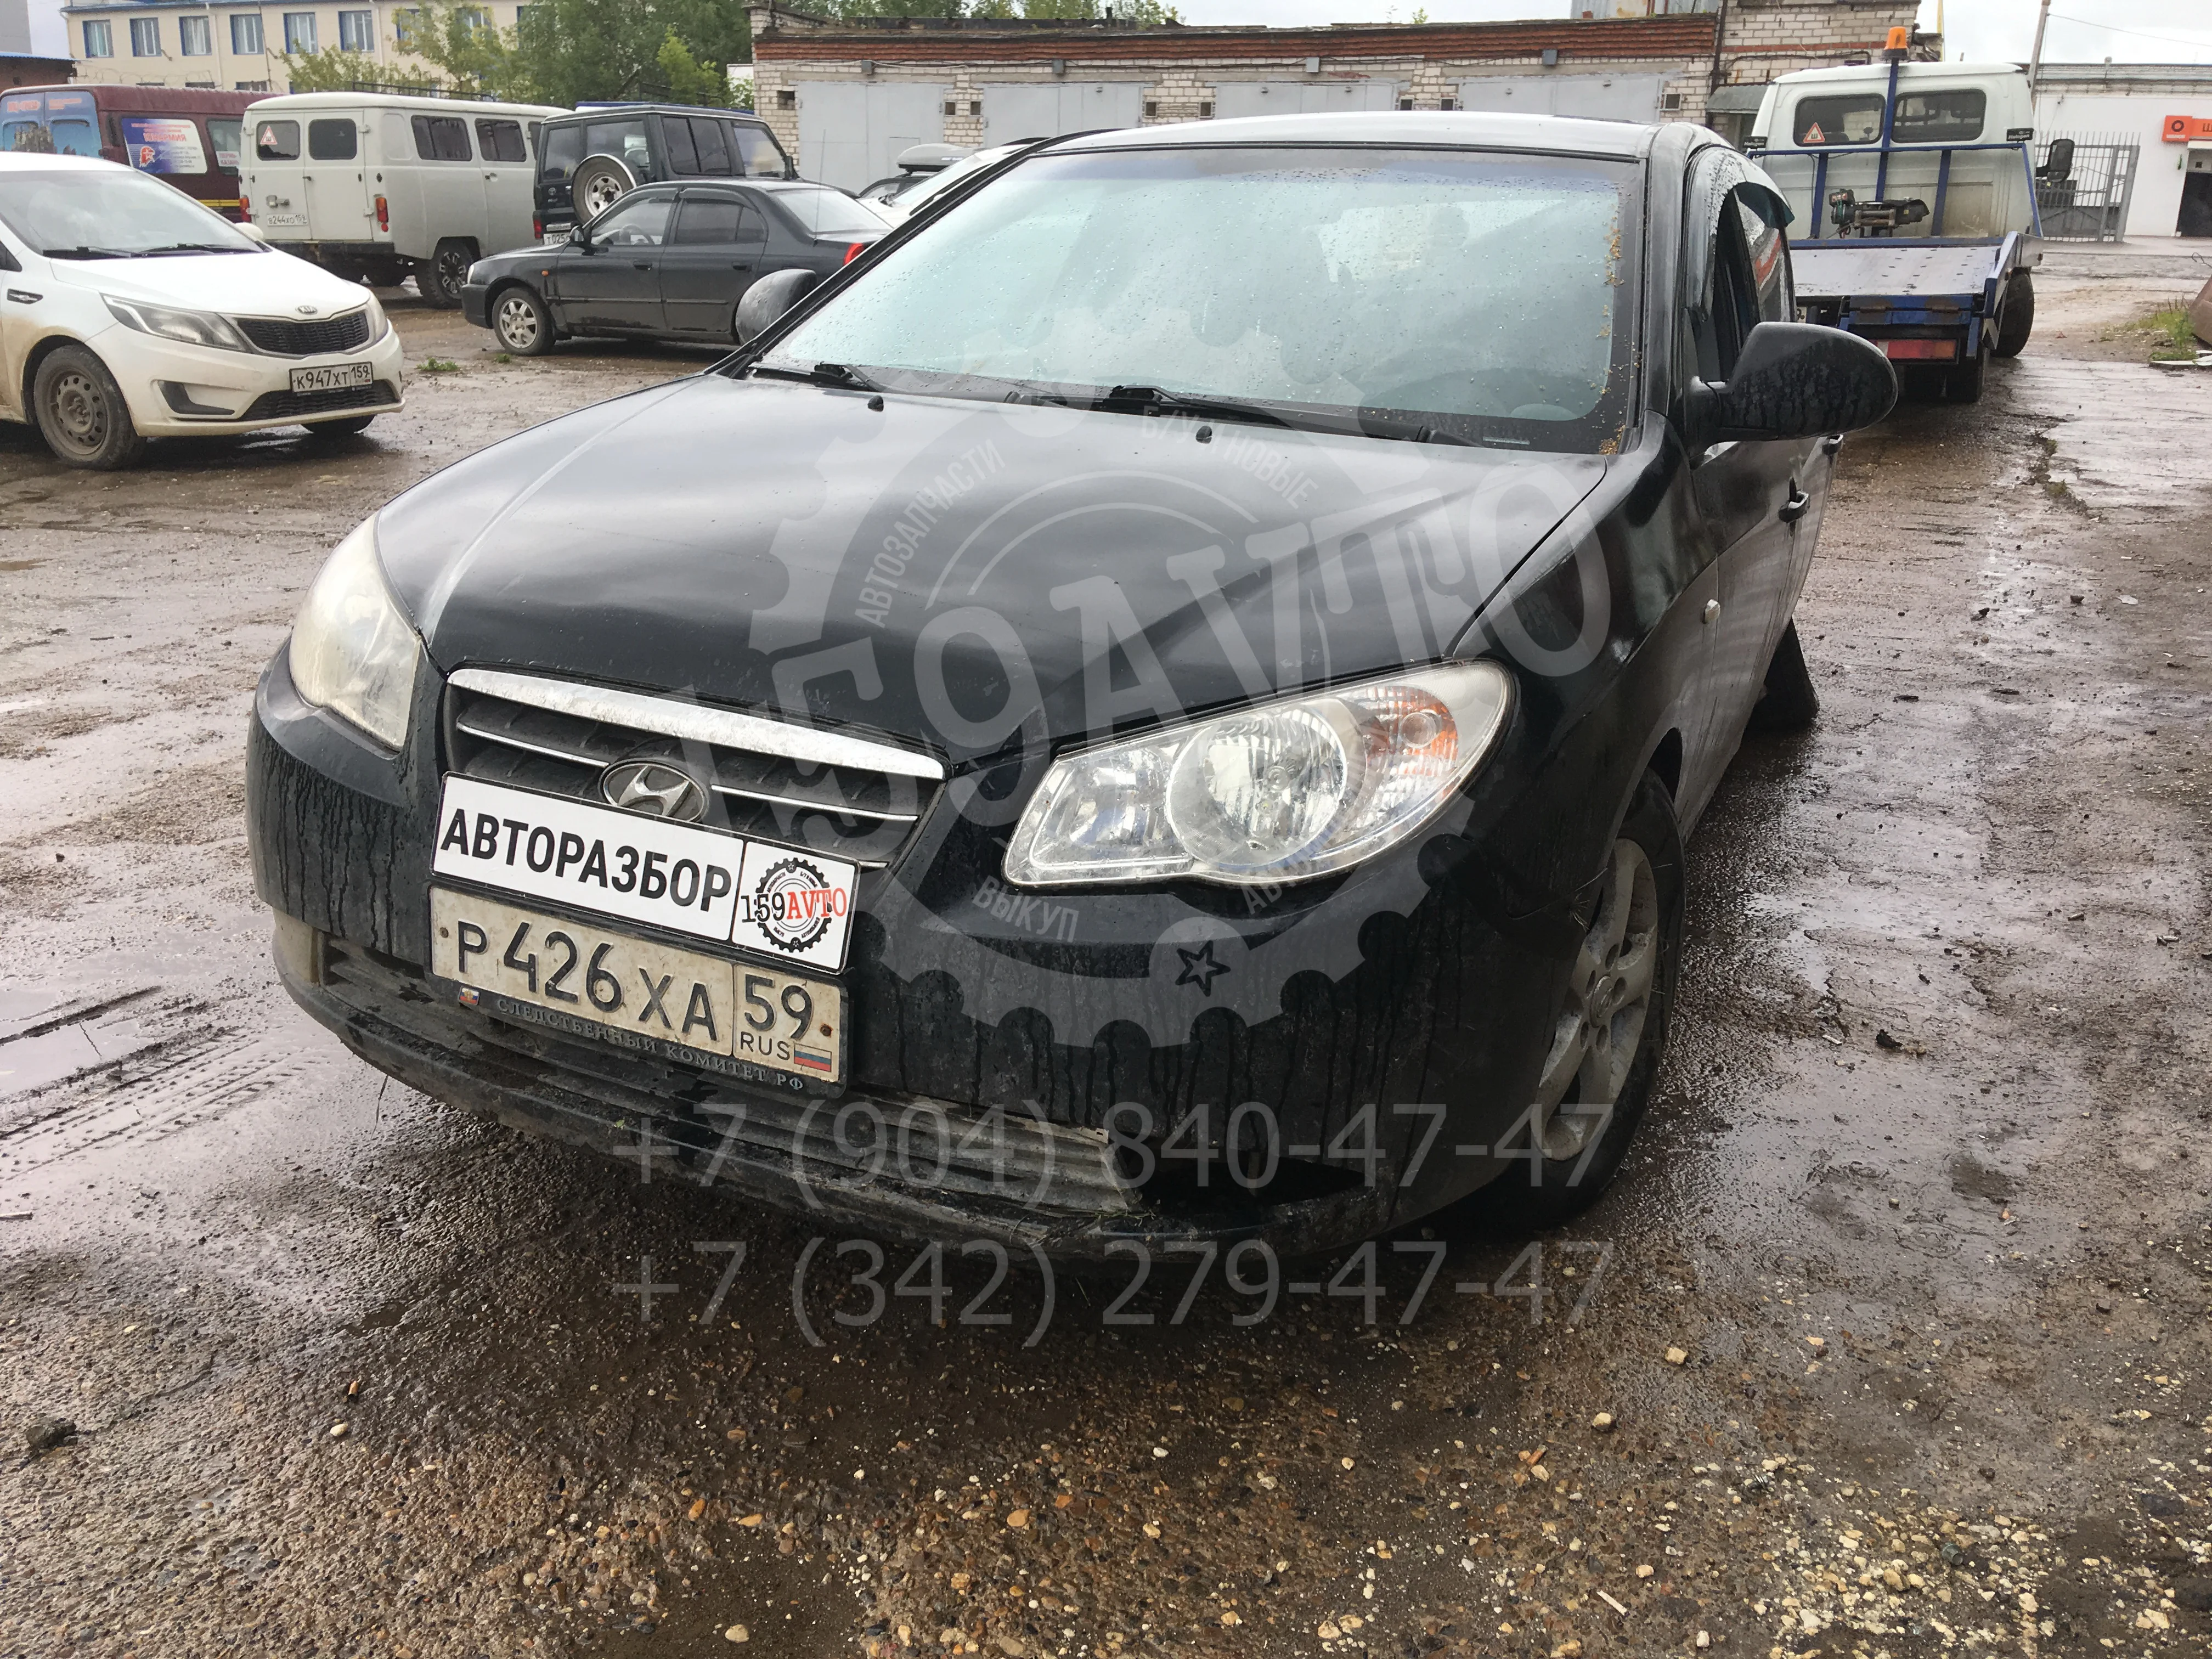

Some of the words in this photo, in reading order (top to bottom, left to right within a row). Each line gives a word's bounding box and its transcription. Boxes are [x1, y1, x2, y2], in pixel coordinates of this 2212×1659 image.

[296, 370, 348, 389] К947ХТ
[351, 365, 369, 379] 159
[441, 808, 732, 912] АВТОРАЗБОР
[741, 888, 847, 923] 159AVTO
[458, 918, 718, 1041] Р426ХА
[743, 974, 815, 1041] 59
[496, 998, 657, 1053] СЛЕДСТВЕННЫЙ
[665, 1042, 767, 1082] КОМИТЕТ
[776, 1073, 804, 1091] РФ
[740, 1031, 791, 1061] RUS
